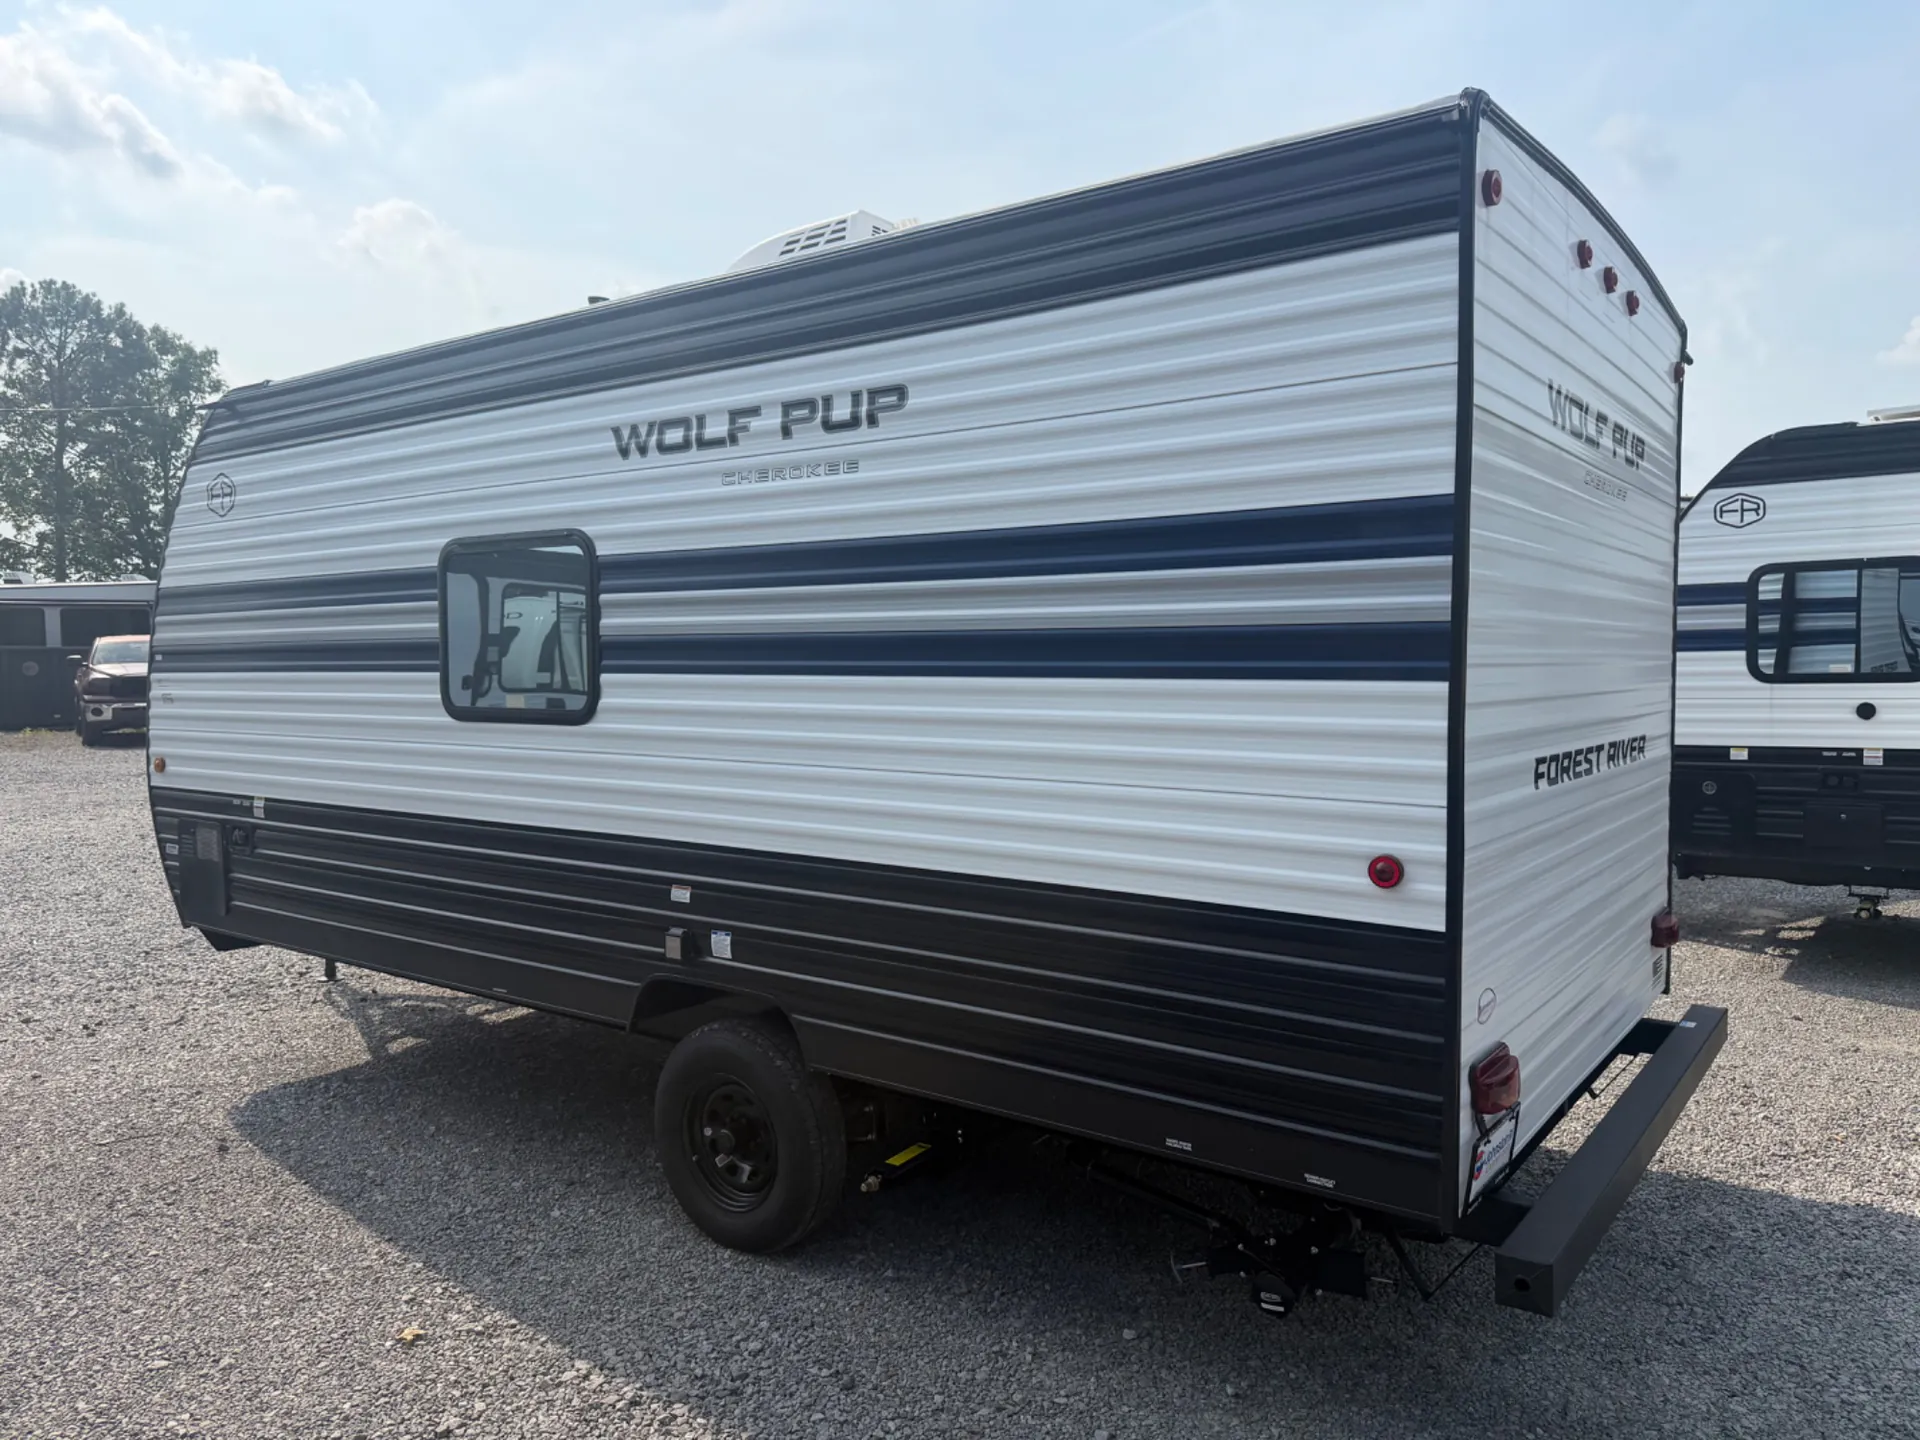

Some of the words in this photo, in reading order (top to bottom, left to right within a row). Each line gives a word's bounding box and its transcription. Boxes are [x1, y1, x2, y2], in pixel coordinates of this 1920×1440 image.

[610, 405, 762, 461] WOLF
[780, 383, 909, 441] PUP
[1547, 378, 1609, 450] WOLF
[1612, 420, 1646, 471] PUP
[721, 460, 860, 486] CHEROKEE
[1533, 743, 1605, 791] FOREST
[1606, 733, 1647, 770] RIVER
